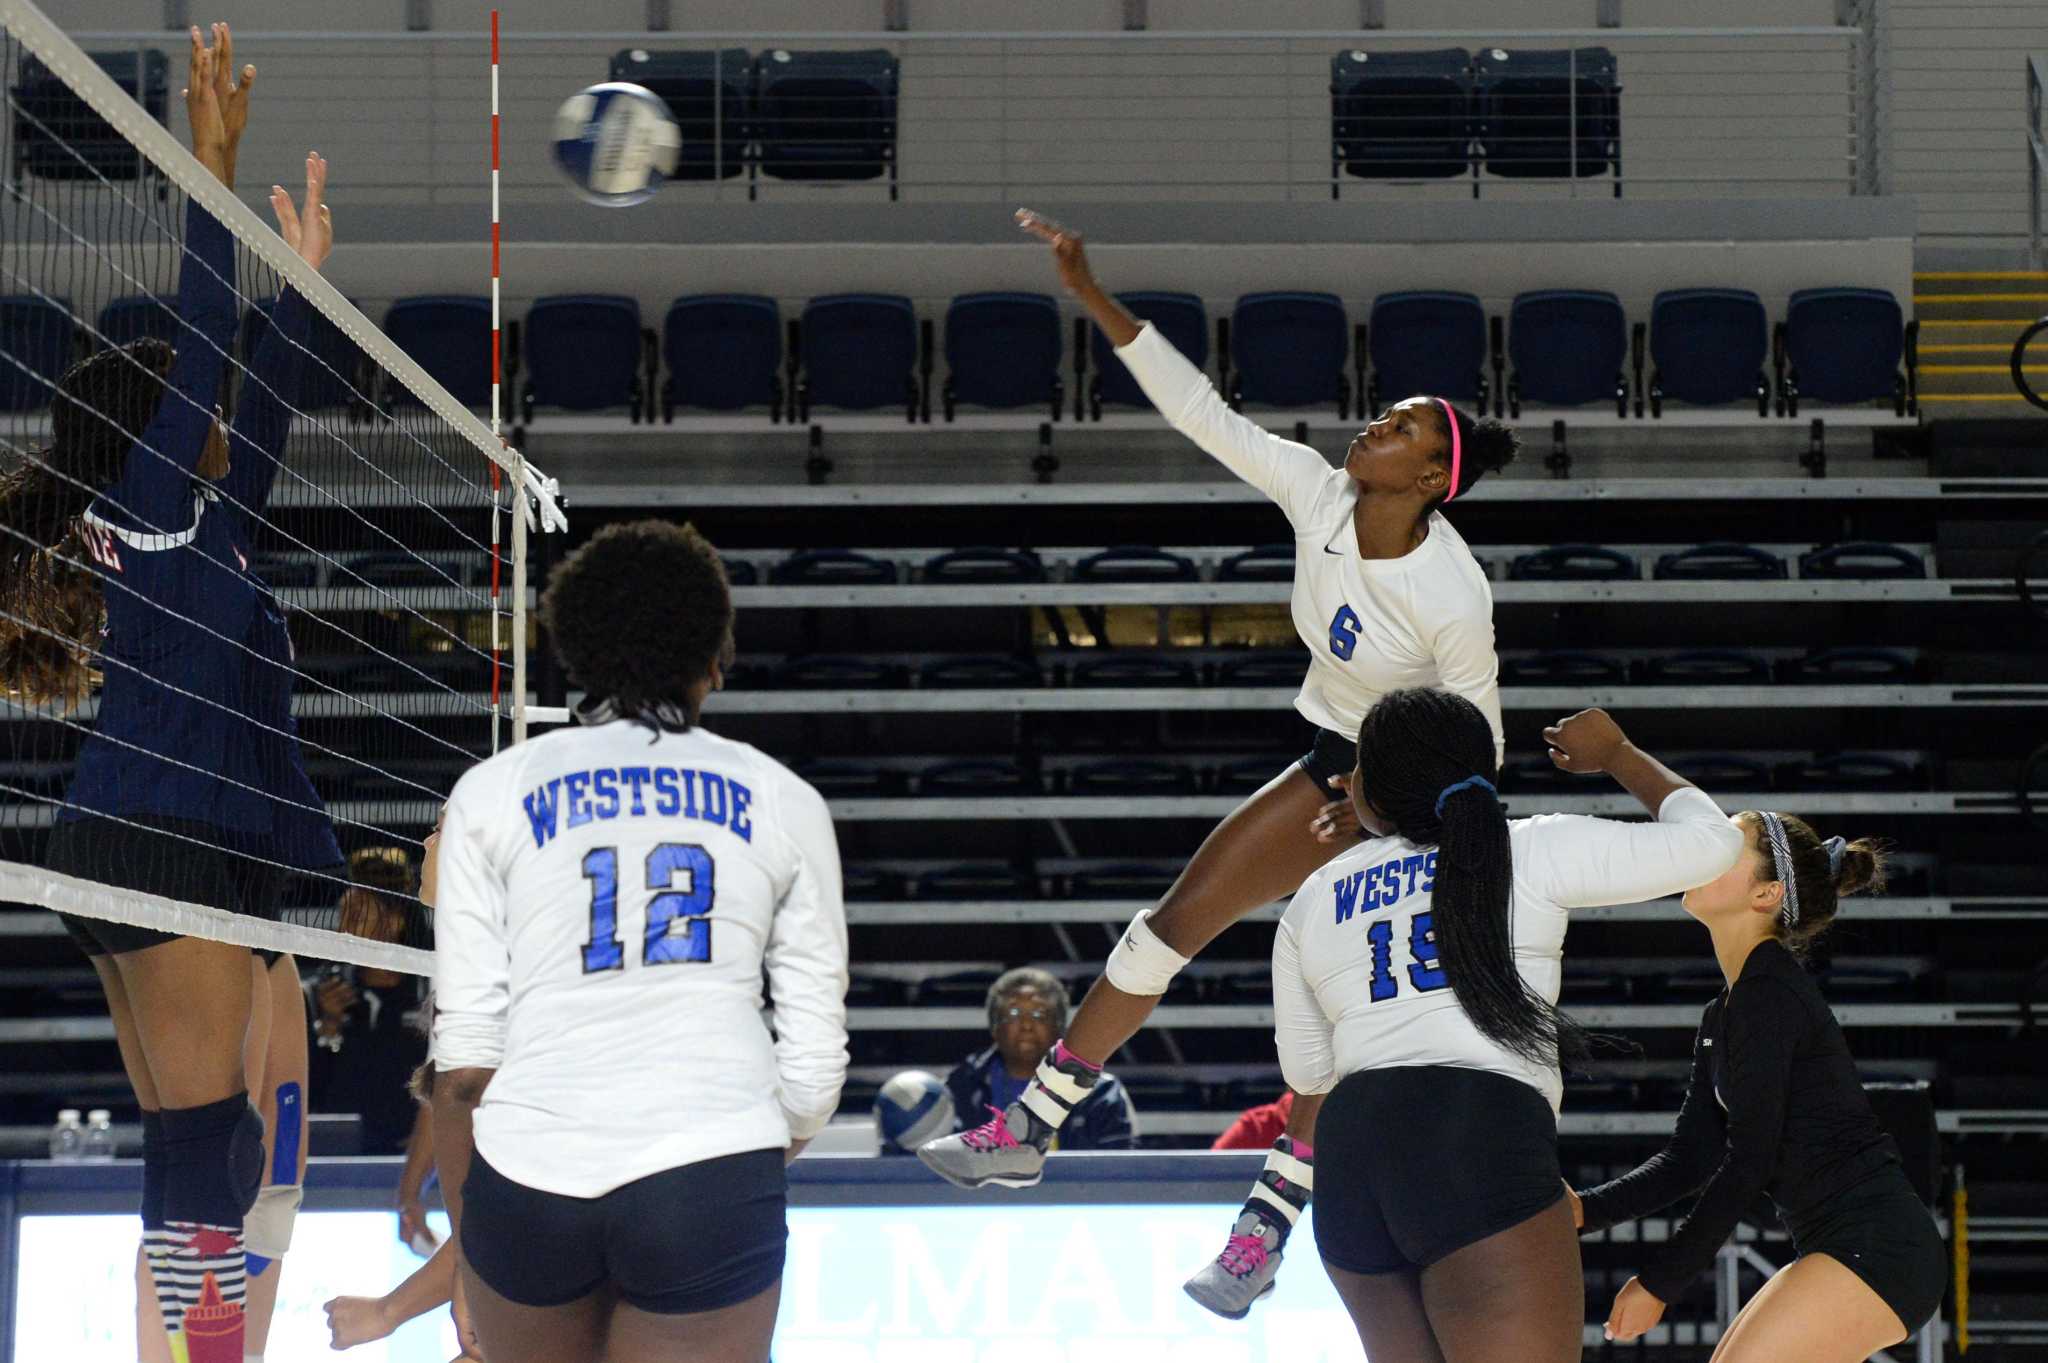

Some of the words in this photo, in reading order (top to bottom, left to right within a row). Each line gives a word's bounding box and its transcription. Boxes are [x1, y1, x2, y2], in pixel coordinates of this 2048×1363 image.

[1329, 603, 1362, 662] 6
[523, 767, 752, 849] WESTSIDE
[580, 842, 715, 975] 12
[1334, 852, 1439, 925] WESTS
